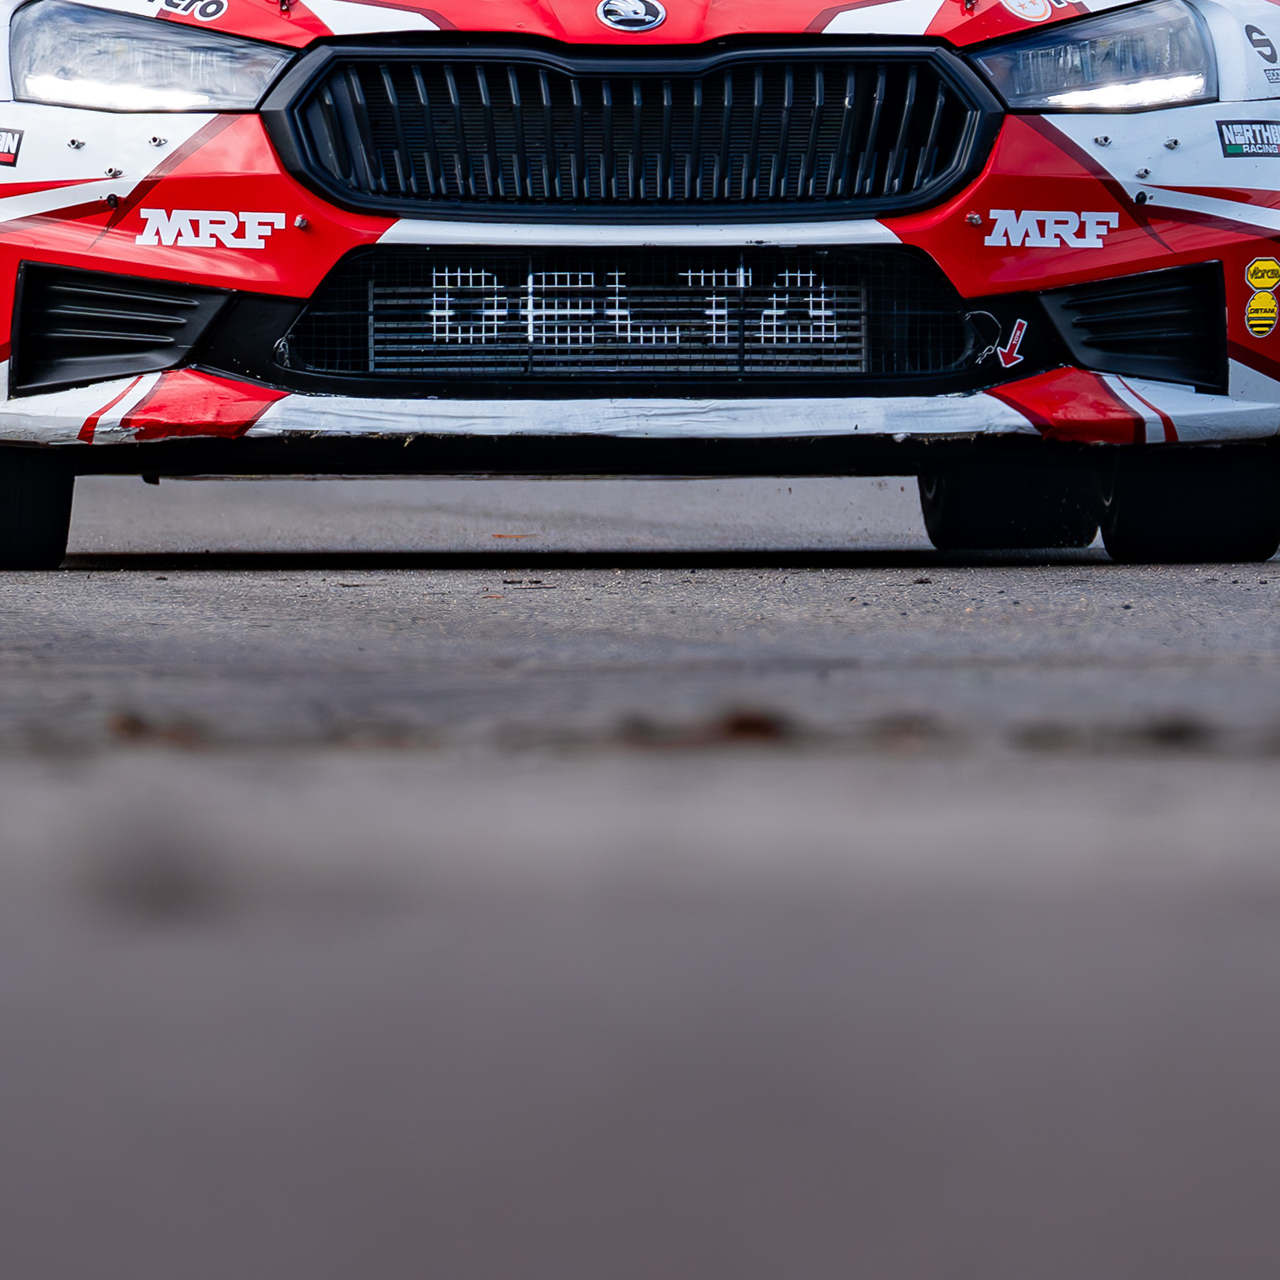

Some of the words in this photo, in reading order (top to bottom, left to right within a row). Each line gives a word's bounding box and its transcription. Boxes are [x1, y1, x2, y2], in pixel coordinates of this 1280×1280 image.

[1242, 144, 1278, 153] RACING
[136, 208, 286, 249] MRF
[984, 208, 1119, 248] MRF
[430, 267, 841, 345] DELTA
[1012, 330, 1021, 344] TOW
